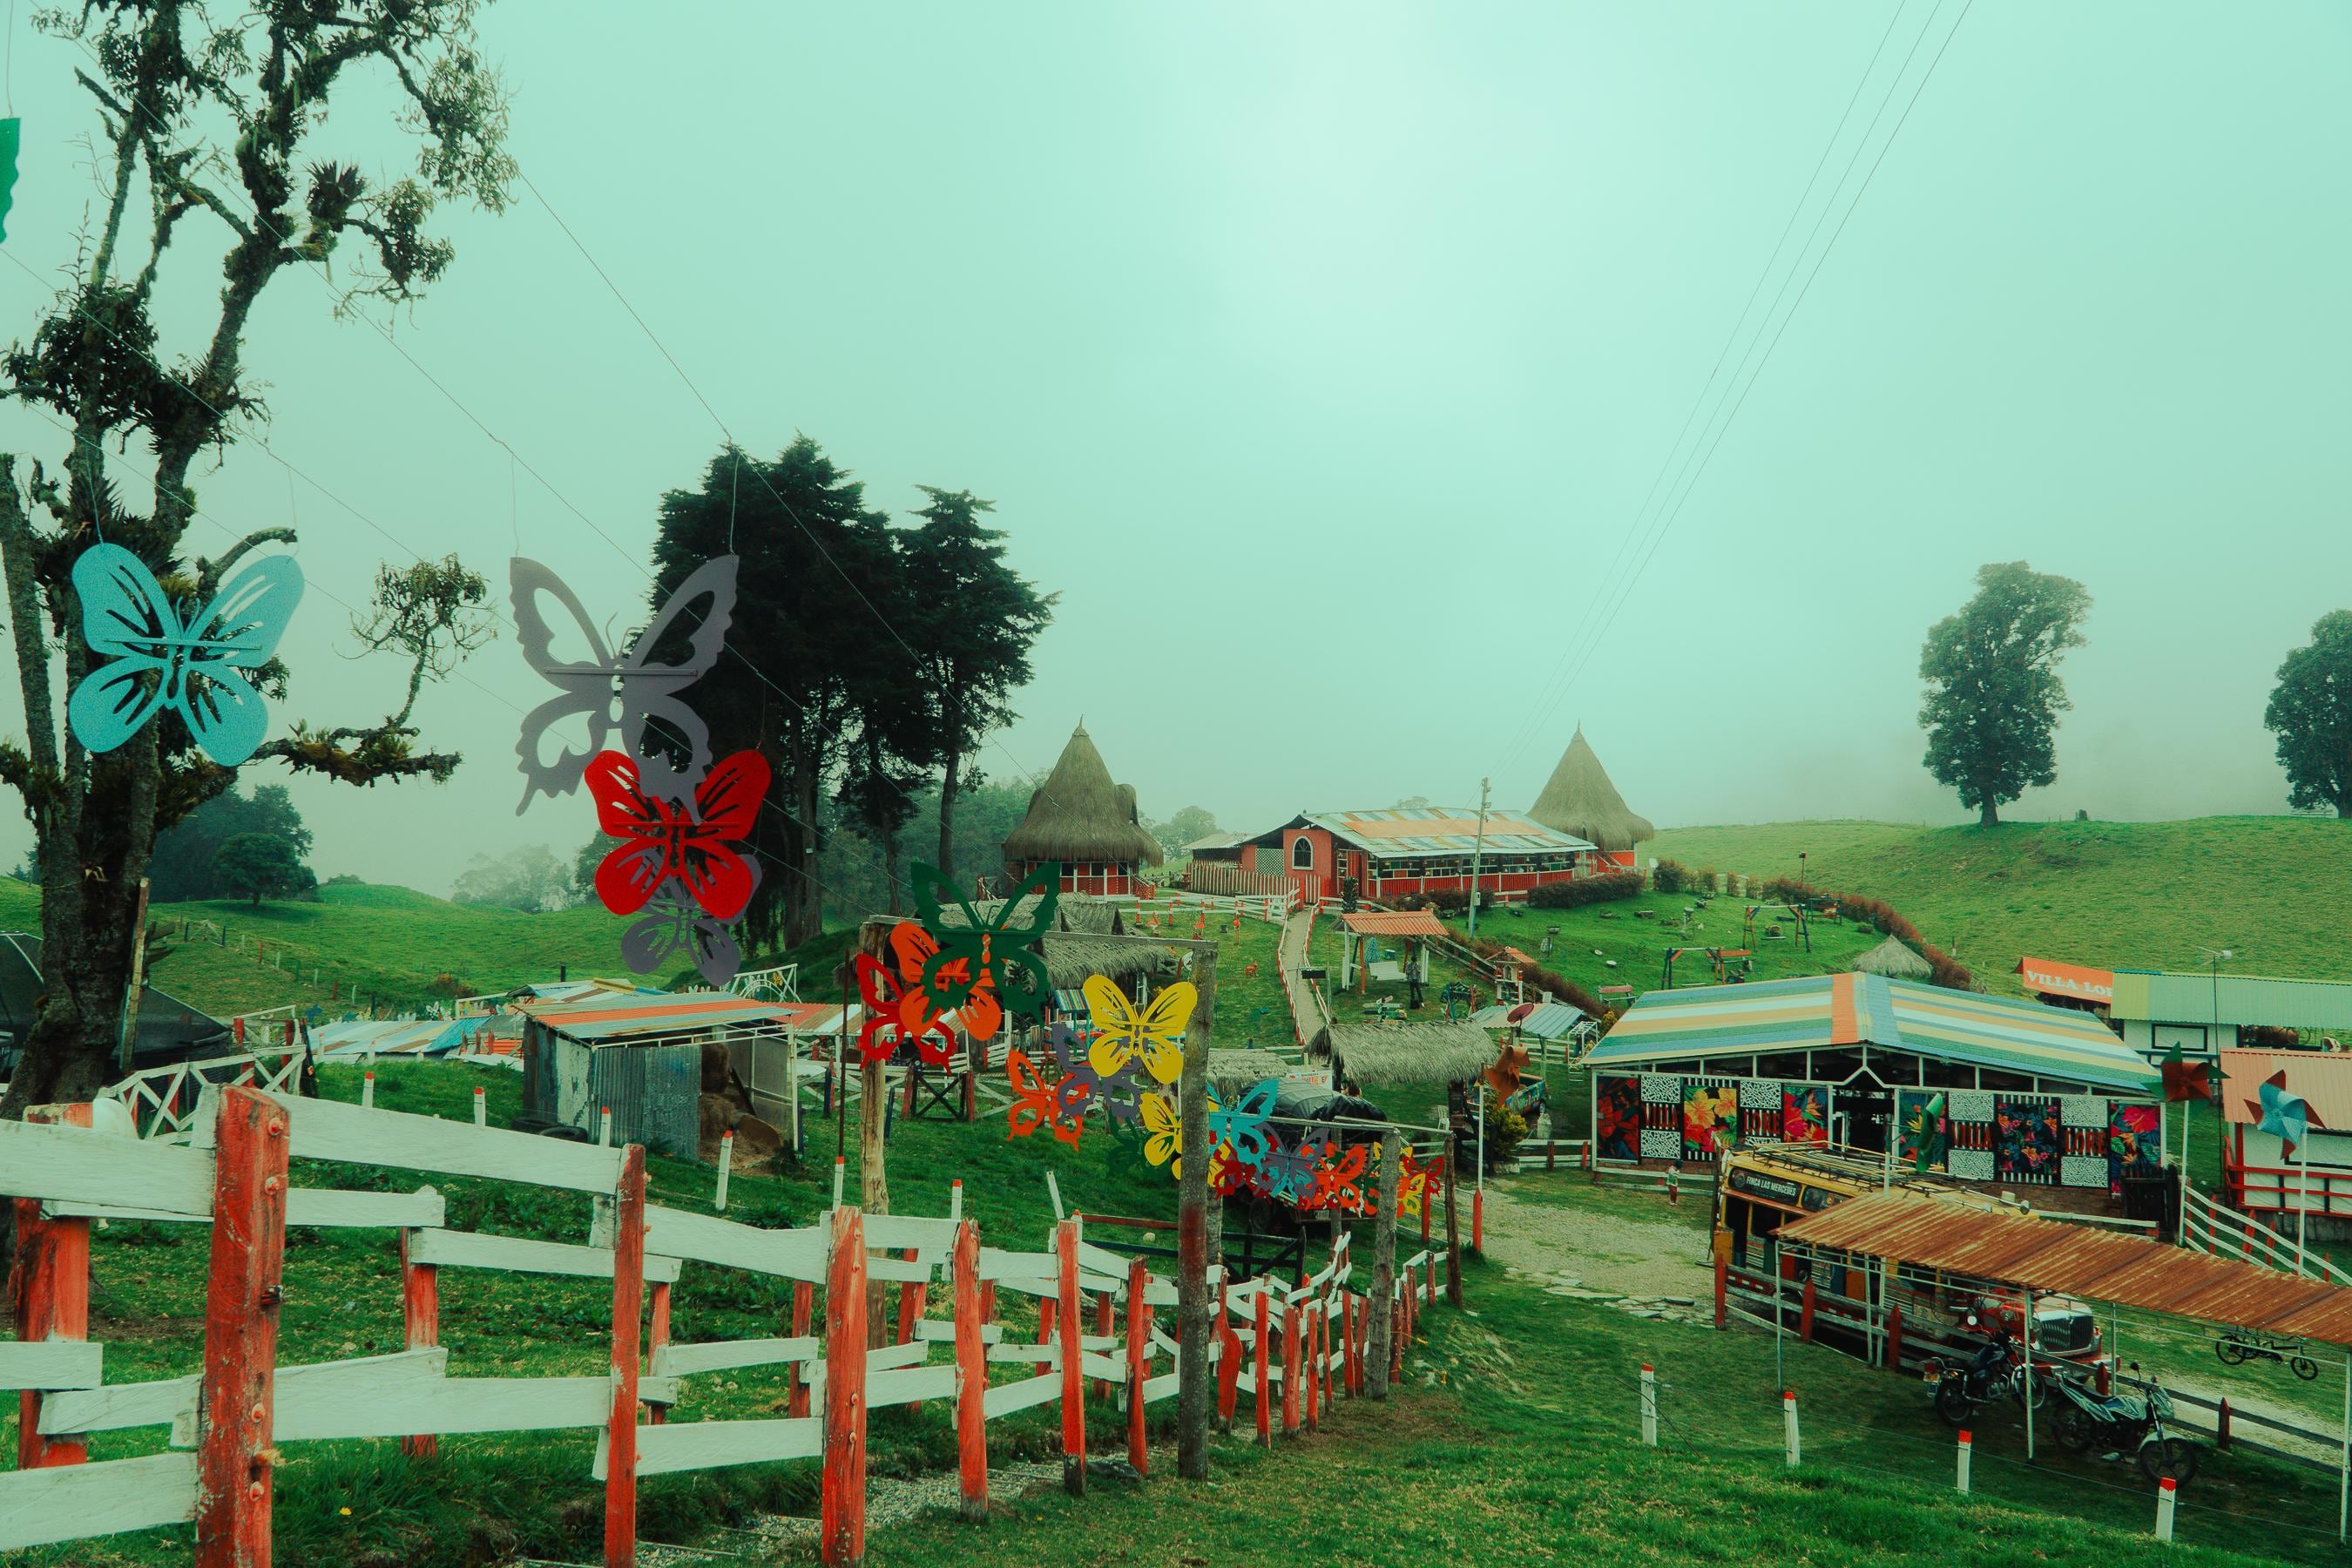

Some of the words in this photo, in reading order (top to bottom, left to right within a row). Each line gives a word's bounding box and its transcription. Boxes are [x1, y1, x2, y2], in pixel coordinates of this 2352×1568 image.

[2026, 970, 2079, 990] VILLA
[1644, 1104, 1678, 1128] VILLA
[1743, 1110, 1780, 1134] LORE
[1951, 1124, 1992, 1148] VILLA
[2065, 1130, 2106, 1154] LORE
[1747, 1176, 1761, 1186] FINCA
[1761, 1179, 1770, 1190] LAS
[1770, 1182, 1796, 1196] MERCEDES
